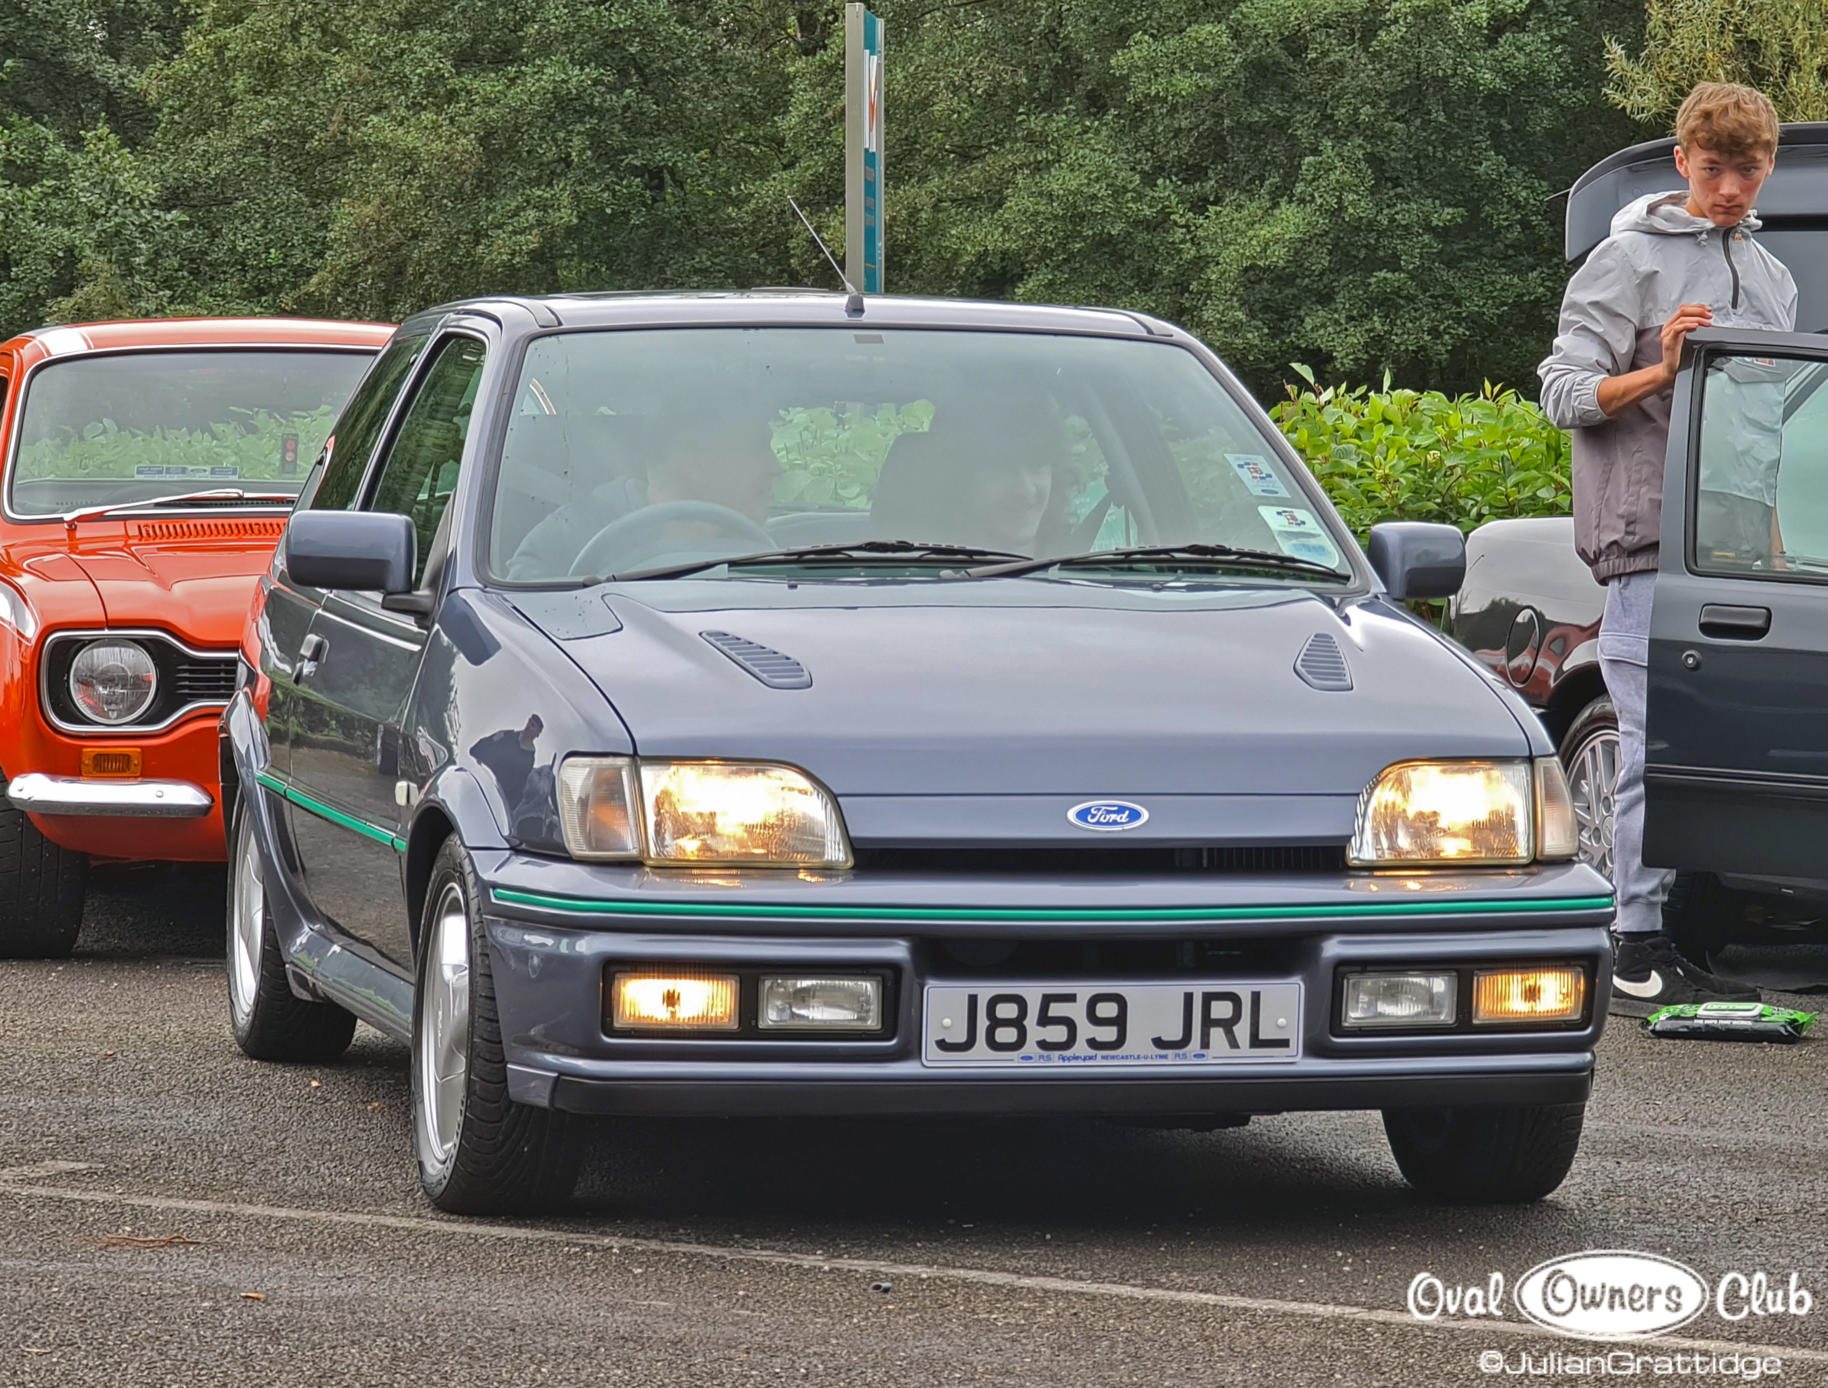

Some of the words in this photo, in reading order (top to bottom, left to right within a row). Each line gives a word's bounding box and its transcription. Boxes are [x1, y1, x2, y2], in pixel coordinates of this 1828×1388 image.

[1087, 806, 1129, 823] Ford
[934, 993, 1128, 1053] J859
[1151, 991, 1290, 1051] JRL
